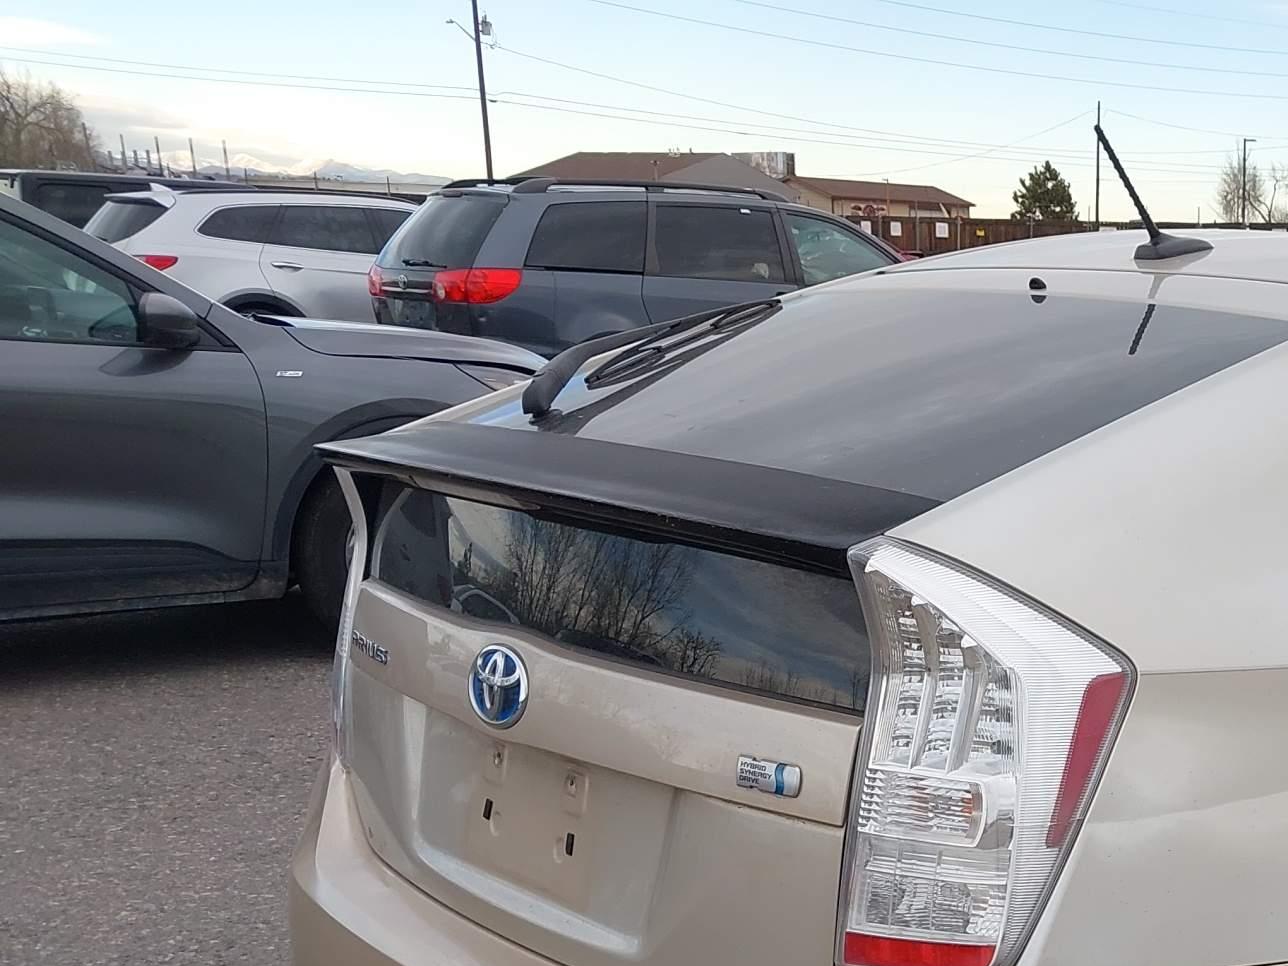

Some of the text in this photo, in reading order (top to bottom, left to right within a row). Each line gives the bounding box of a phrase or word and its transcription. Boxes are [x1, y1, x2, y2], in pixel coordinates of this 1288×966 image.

[740, 760, 767, 771] HYBRID
[738, 775, 760, 784] DRIVE
[739, 768, 772, 780] SYNERGY
